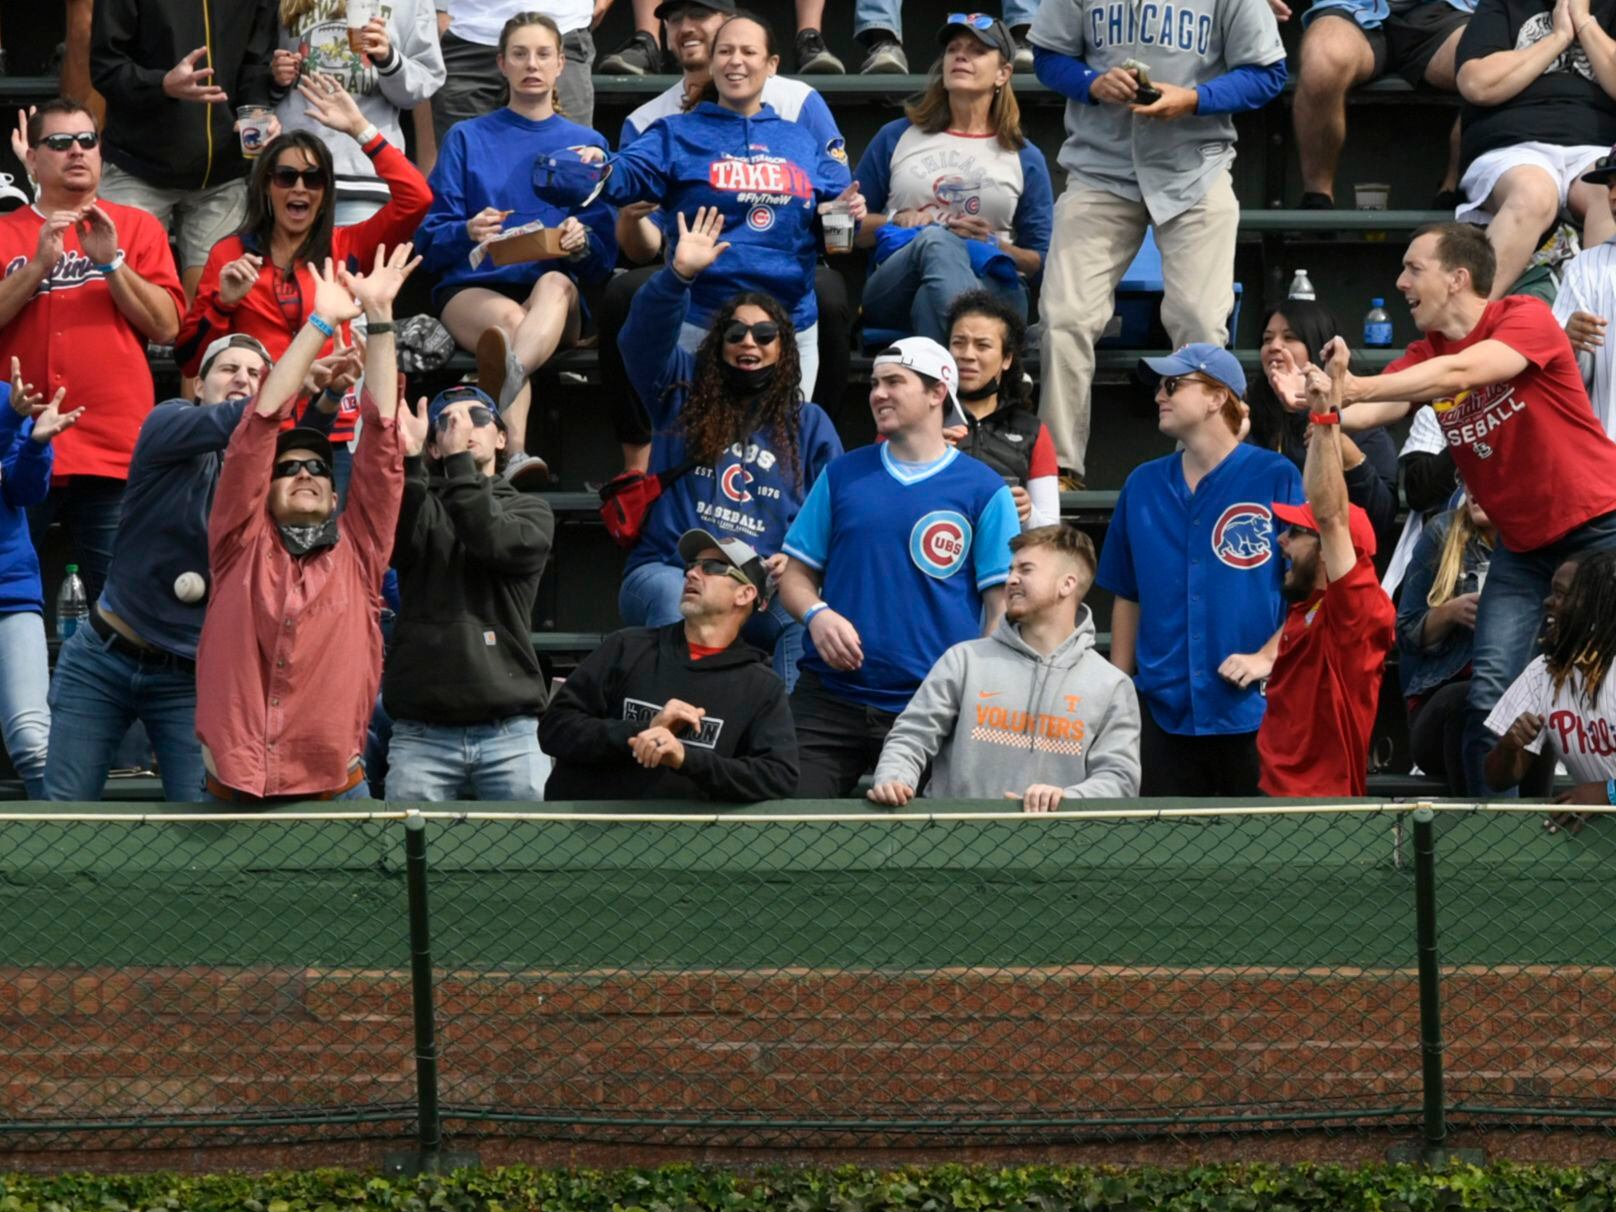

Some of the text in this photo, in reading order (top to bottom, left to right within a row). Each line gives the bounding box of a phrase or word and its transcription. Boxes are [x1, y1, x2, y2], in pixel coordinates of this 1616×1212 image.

[1091, 2, 1212, 56] CHICAGO
[712, 160, 784, 191] TAKE
[1447, 398, 1526, 446] SEBALL
[696, 501, 766, 532] BASEBALL
